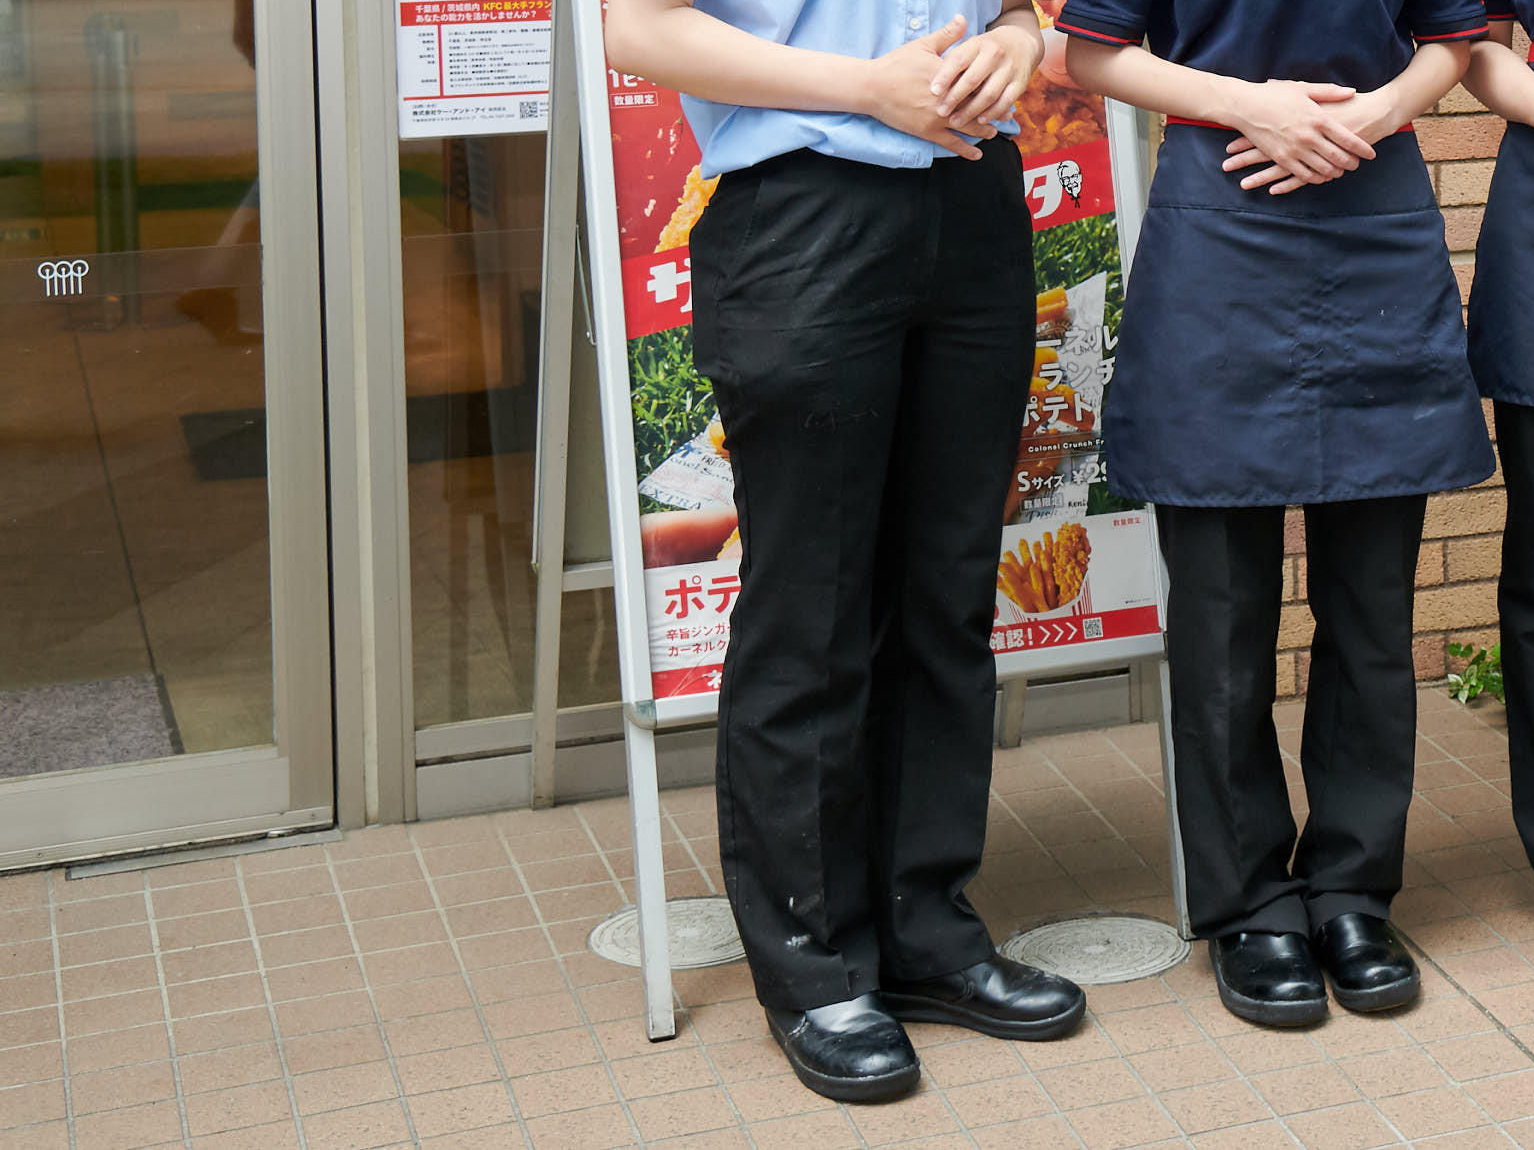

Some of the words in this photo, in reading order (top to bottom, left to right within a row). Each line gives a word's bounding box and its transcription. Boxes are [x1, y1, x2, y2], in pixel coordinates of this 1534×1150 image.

[483, 1, 503, 10] KFC
[614, 94, 655, 106] 数量限定
[1028, 441, 1061, 453] Colonel
[1063, 438, 1093, 450] Crunch
[1017, 471, 1065, 492] Sサイズ
[664, 575, 742, 619] ポテ
[668, 640, 727, 657] カーネルク
